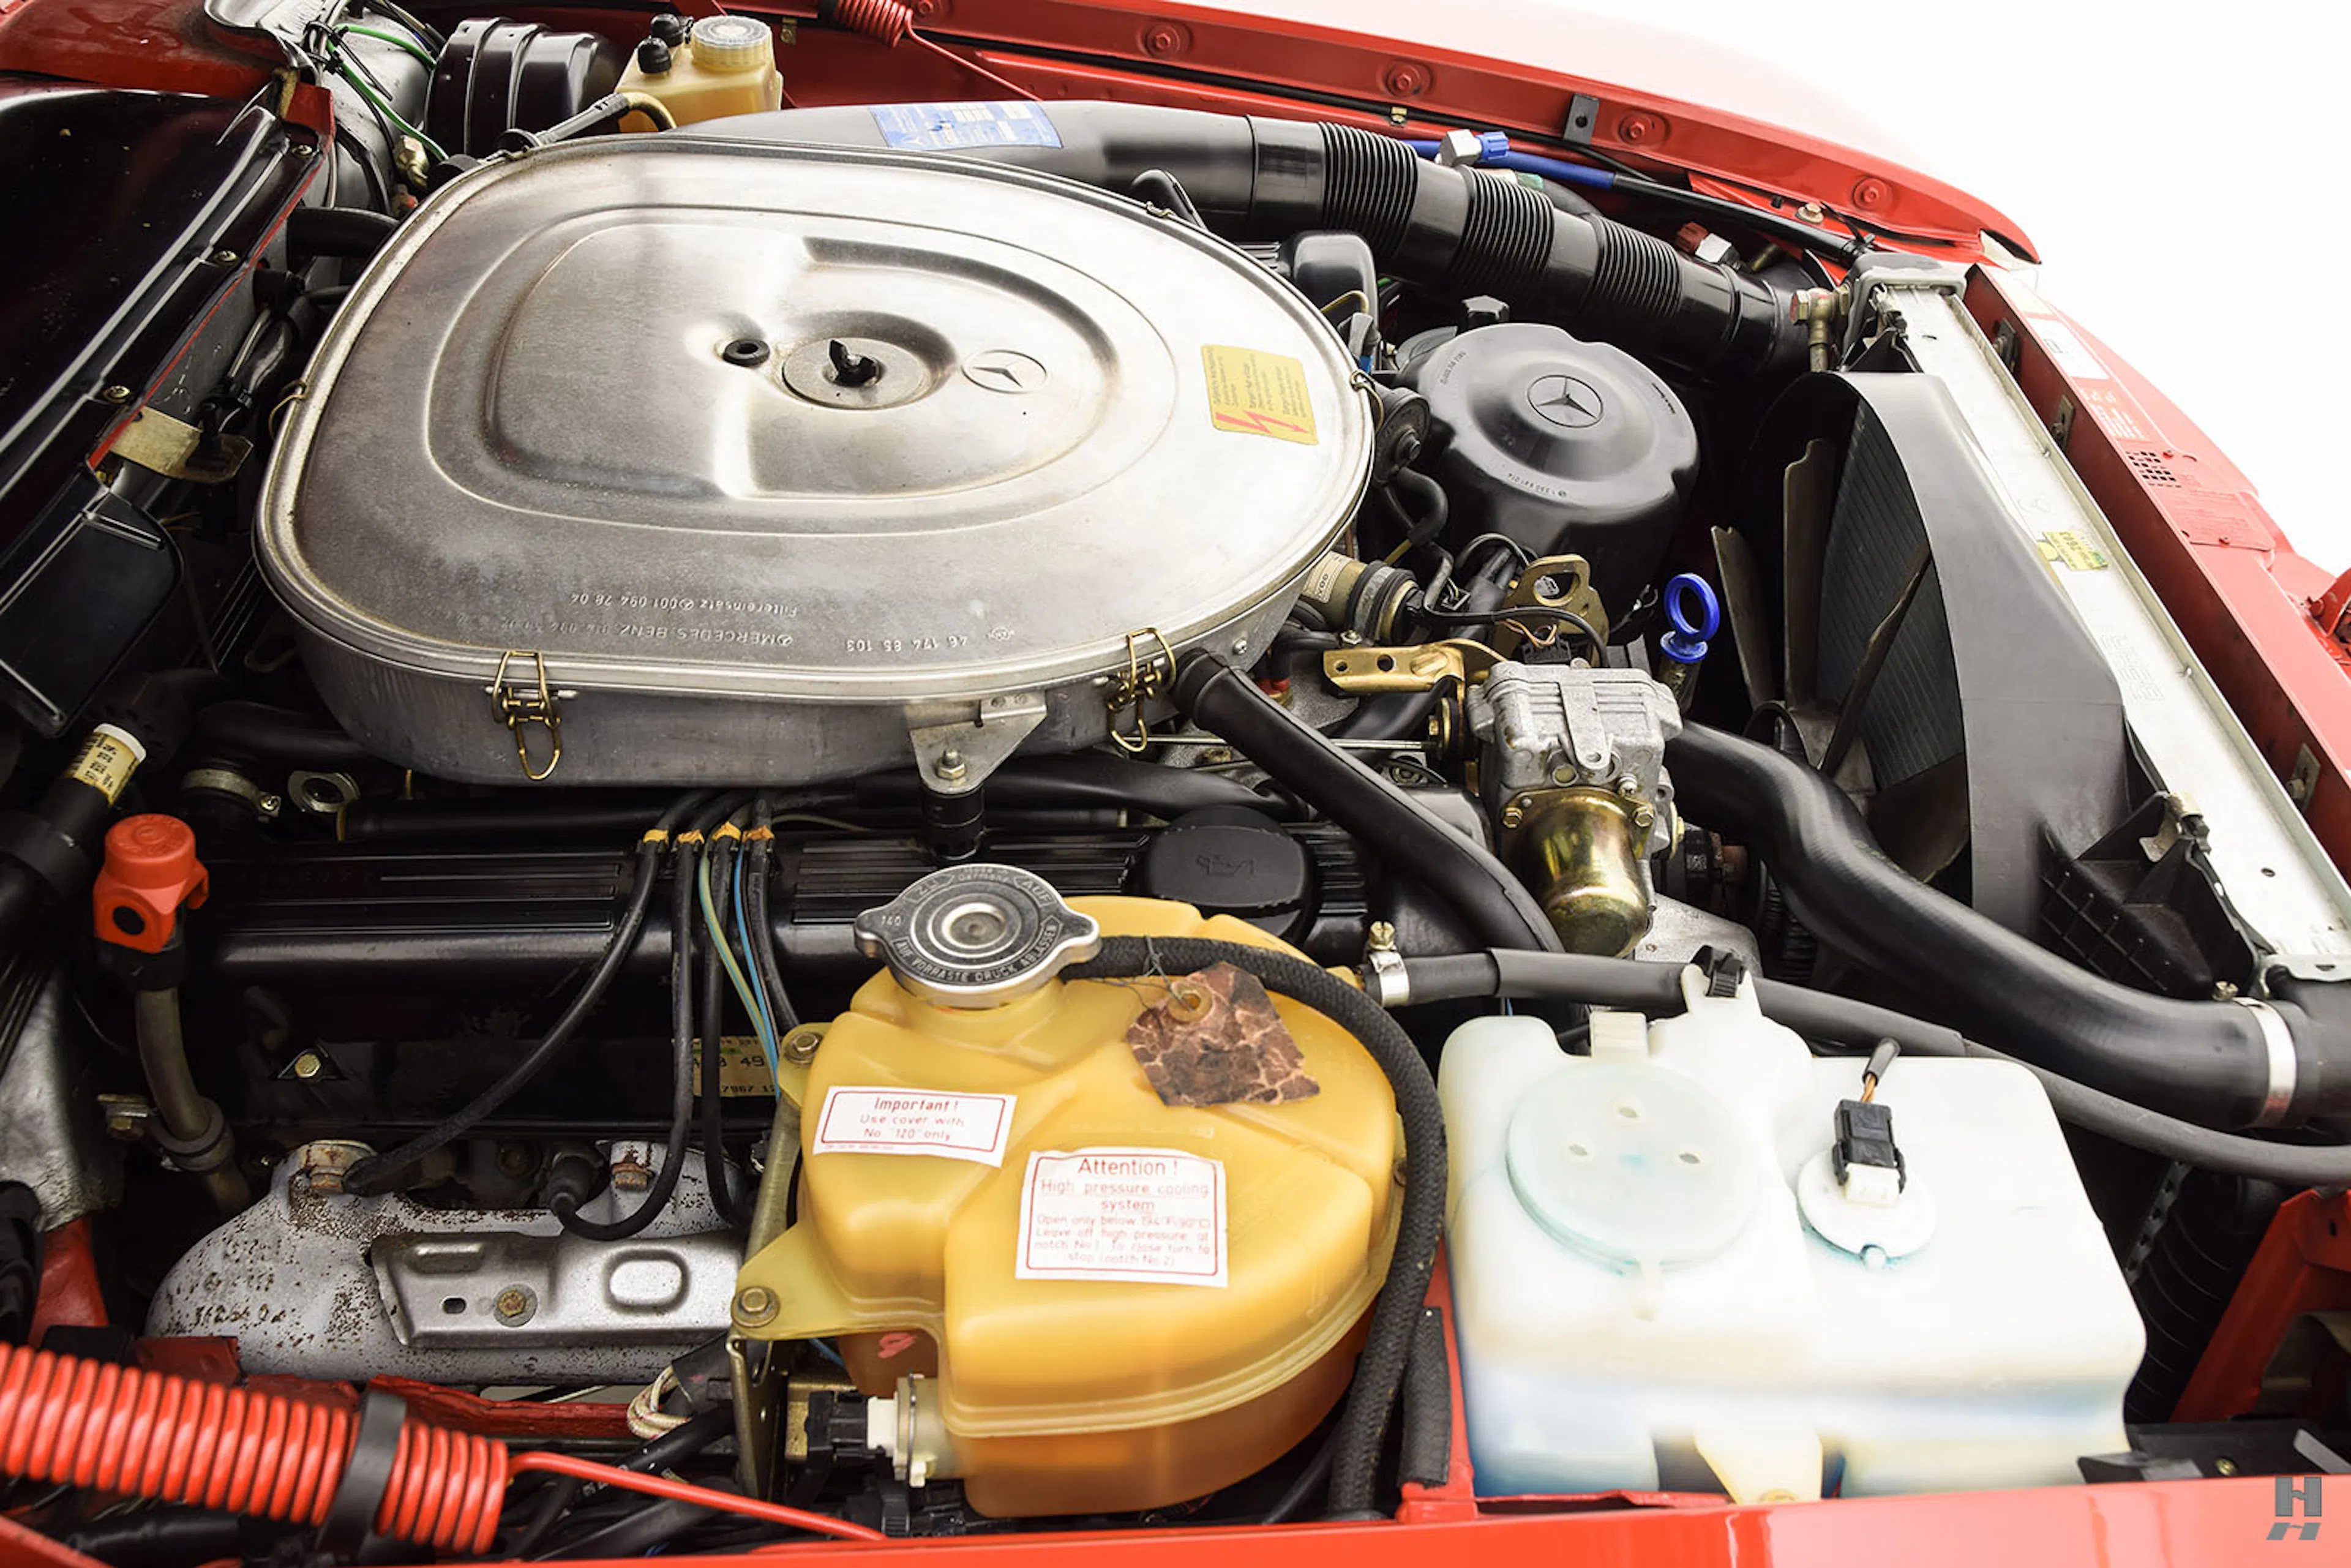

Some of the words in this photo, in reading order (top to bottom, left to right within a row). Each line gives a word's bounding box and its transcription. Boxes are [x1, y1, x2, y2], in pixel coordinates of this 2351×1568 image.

[846, 640, 873, 653] 103
[958, 873, 1010, 883] Germany
[1022, 880, 1052, 905] AUF
[880, 915, 902, 927] 140
[896, 941, 914, 958] AUF
[974, 964, 1018, 981] DRUCK
[1020, 925, 1057, 967] ABLASSEN
[874, 1097, 950, 1113] Important
[860, 1113, 887, 1125] Use
[892, 1115, 929, 1125] cover
[934, 1117, 966, 1127] with
[923, 1130, 951, 1141] only
[1078, 1157, 1166, 1176] Attention
[1041, 1179, 1074, 1194] High
[1084, 1182, 1150, 1196] pressure
[1157, 1183, 1210, 1198] cooling
[1100, 1198, 1155, 1212] system
[1037, 1213, 1067, 1225] Open
[1071, 1216, 1095, 1226] only
[1100, 1216, 1136, 1225] below
[1036, 1228, 1071, 1237] Leave
[1078, 1228, 1093, 1237] off
[1101, 1228, 1127, 1240] high
[1134, 1231, 1187, 1242] pressure
[1034, 1239, 1068, 1249] notch
[1168, 1244, 1193, 1253] turn
